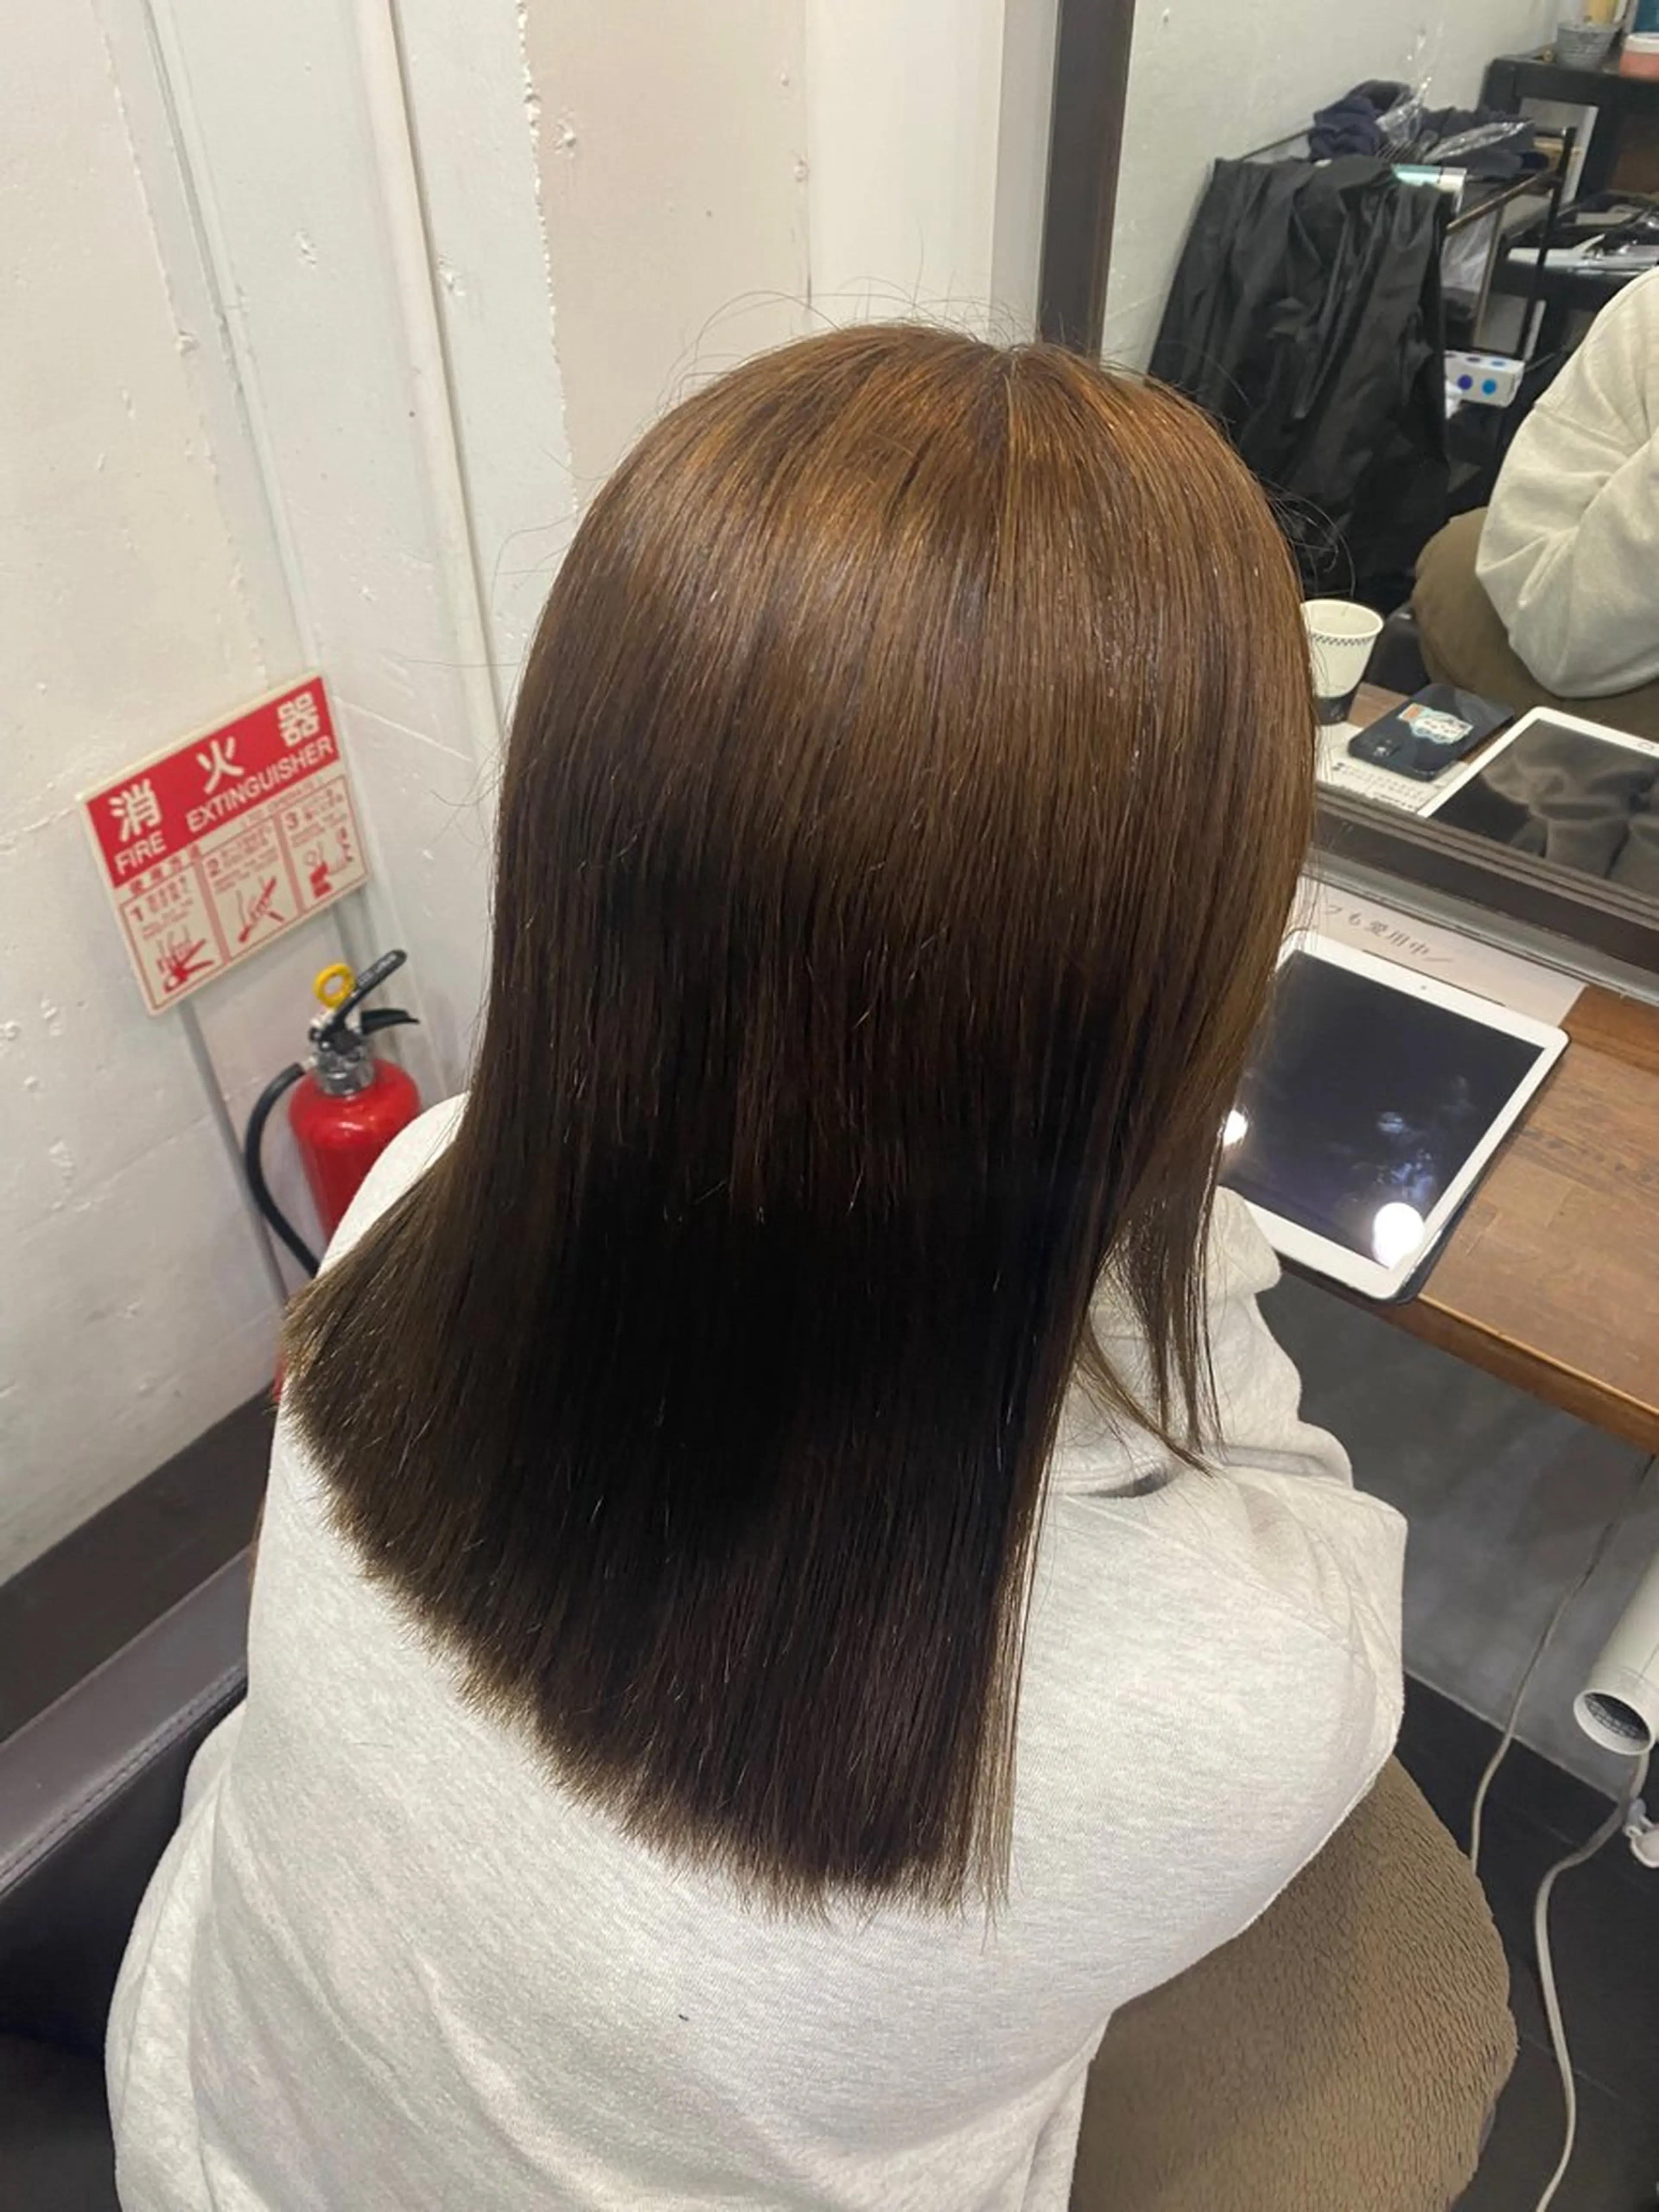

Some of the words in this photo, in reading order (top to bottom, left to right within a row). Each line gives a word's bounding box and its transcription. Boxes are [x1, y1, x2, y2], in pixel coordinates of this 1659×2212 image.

[114, 830, 167, 875] FIRE
[185, 735, 334, 833] EXTINGUISHER
[285, 812, 299, 830] 3
[207, 858, 220, 877] 2
[131, 907, 143, 922] 1
